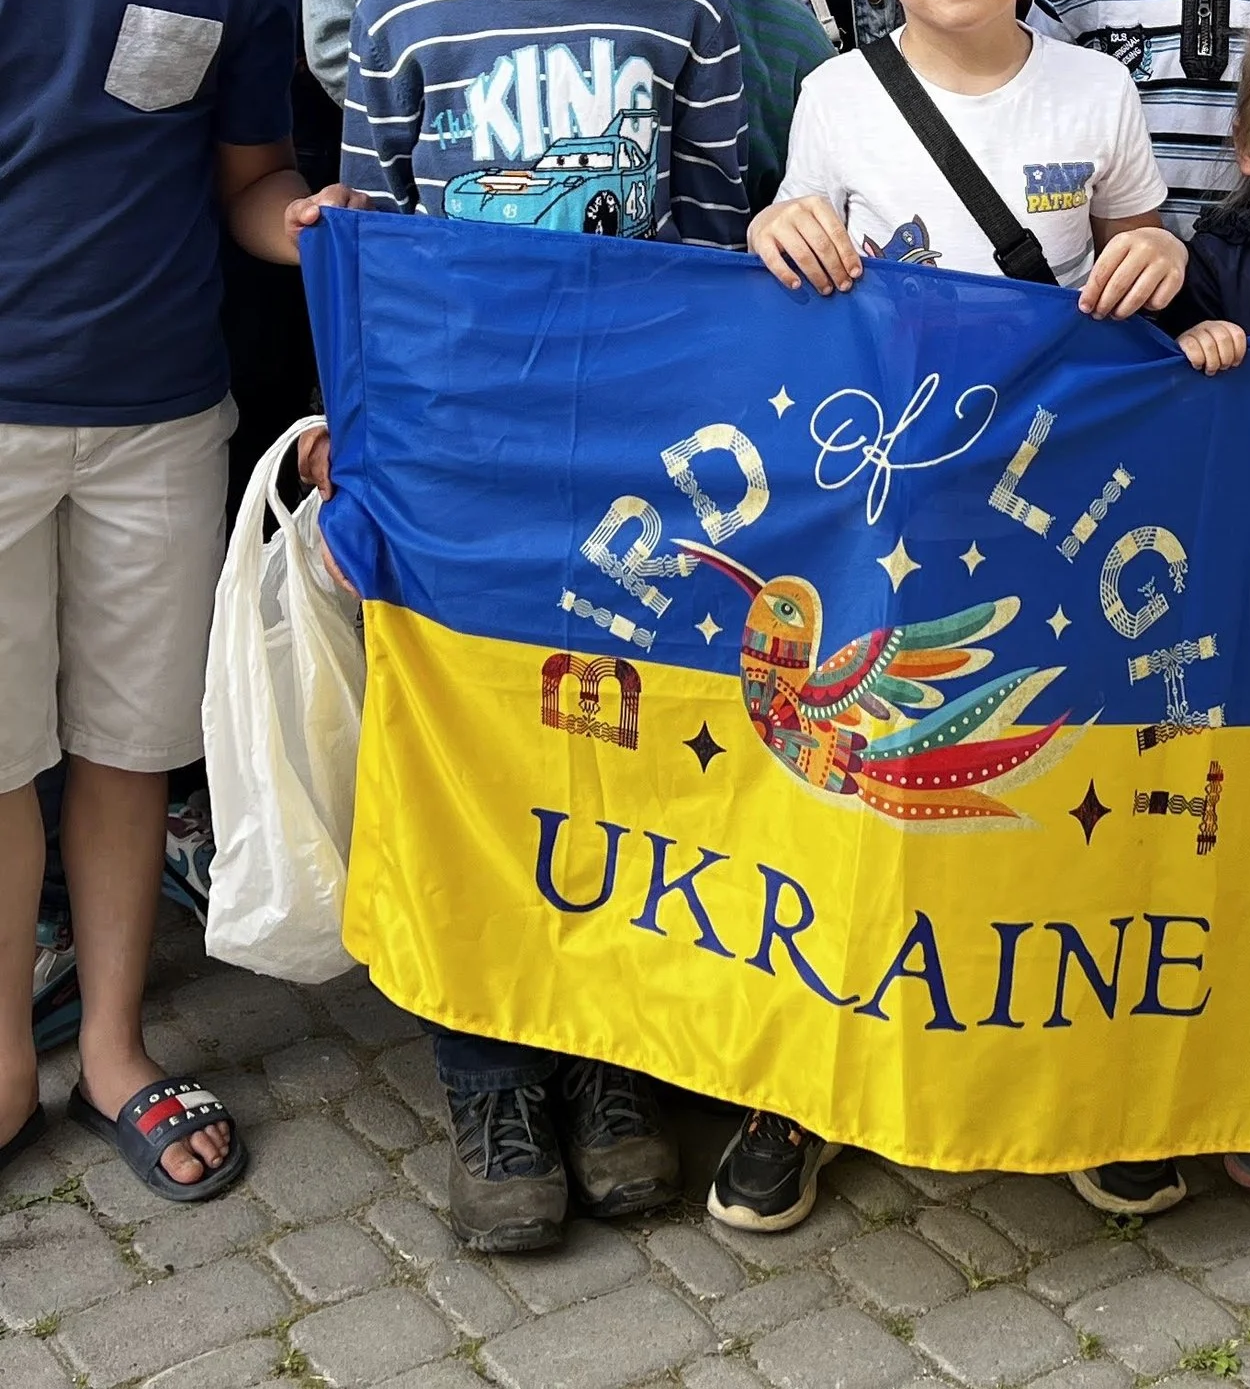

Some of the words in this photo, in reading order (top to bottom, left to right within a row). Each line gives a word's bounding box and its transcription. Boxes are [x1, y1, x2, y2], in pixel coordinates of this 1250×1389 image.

[465, 37, 654, 161] KING
[1023, 162, 1095, 194] PAW
[1027, 189, 1088, 213] PATROL
[540, 423, 770, 751] BIRD
[987, 404, 1226, 855] LIGHT
[531, 807, 1212, 1032] UKRAINE
